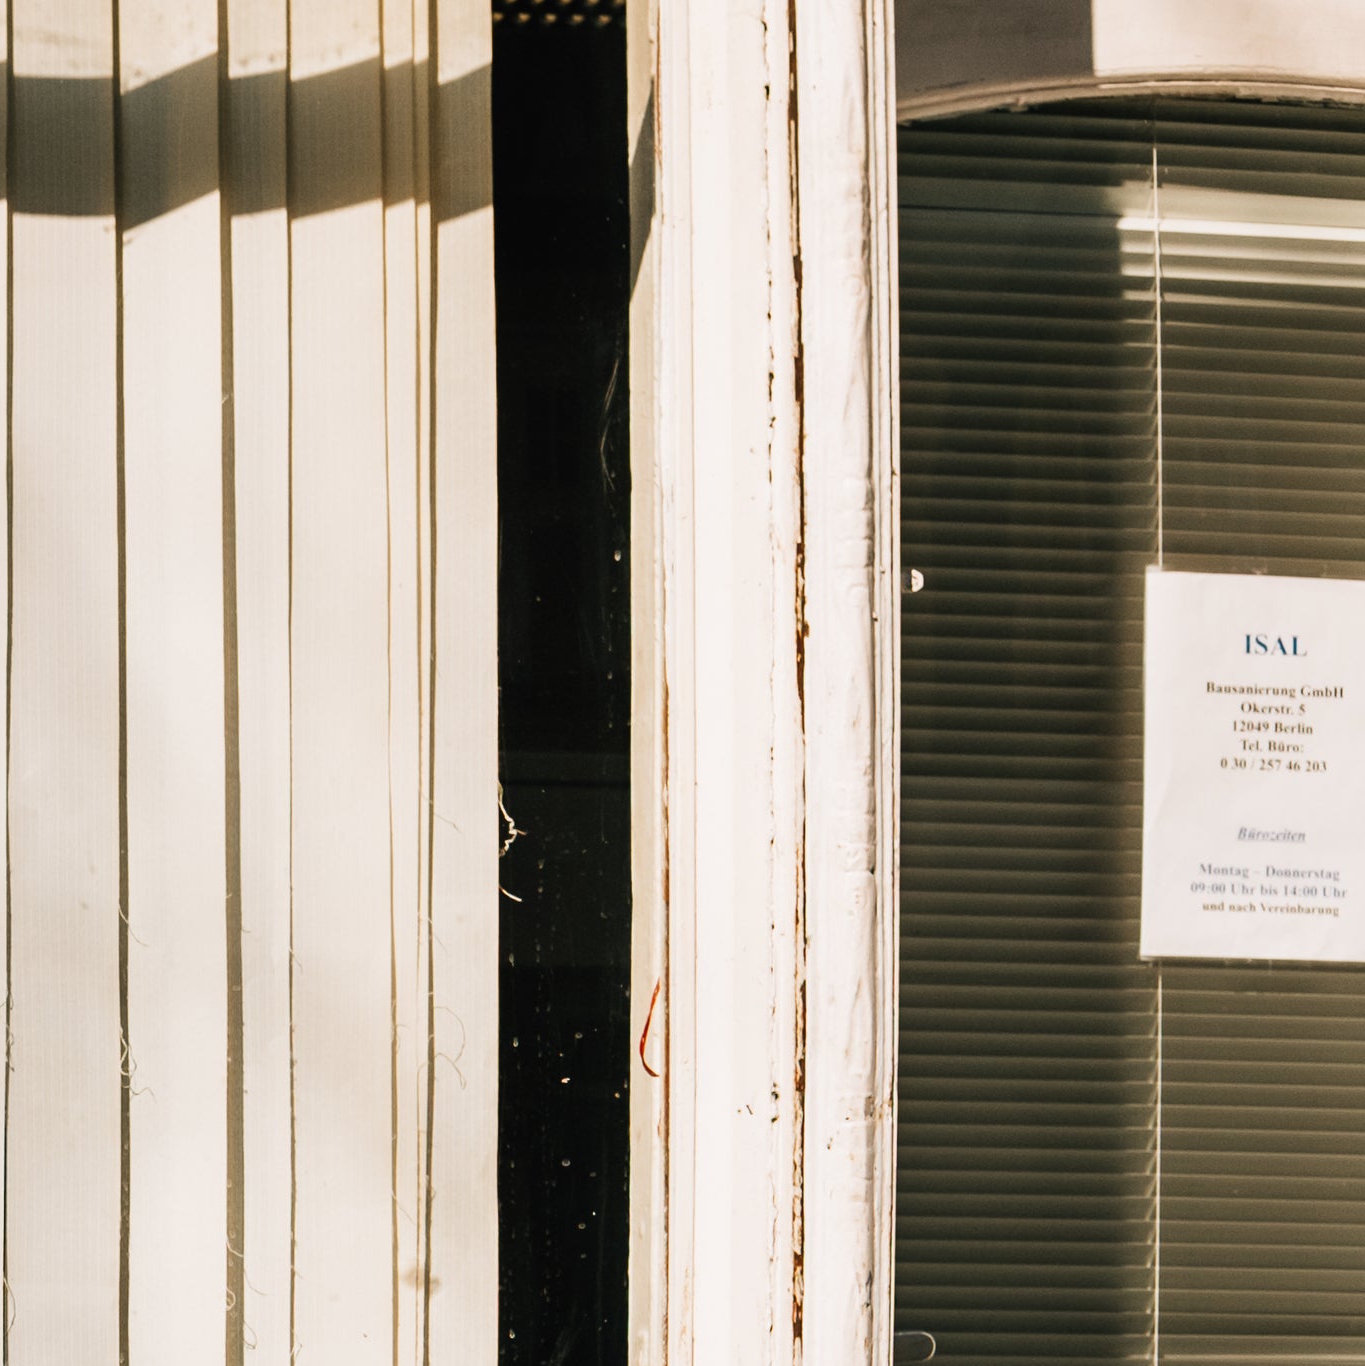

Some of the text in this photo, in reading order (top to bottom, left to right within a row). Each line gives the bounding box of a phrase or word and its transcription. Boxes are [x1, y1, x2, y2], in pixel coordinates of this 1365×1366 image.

[1245, 634, 1308, 657] ISAL
[1206, 681, 1344, 699] Bausanierung GmbH
[1241, 702, 1306, 715] Okerstr. 5
[1232, 720, 1313, 735] 12049 Berlin
[1240, 739, 1304, 753] Tel. Büro:
[1220, 758, 1228, 769] 0
[1231, 758, 1247, 769] 30
[1259, 760, 1281, 771] 257
[1286, 761, 1300, 771] 46
[1305, 761, 1327, 772] 203
[1237, 826, 1307, 842] Bürozeiten
[1200, 863, 1249, 878] Montag
[1265, 865, 1340, 881] Donnerstag
[1190, 882, 1347, 898] 09:00 Uhr bis 14:00 Uhr
[1202, 901, 1340, 918] und nach Vereinbarung
